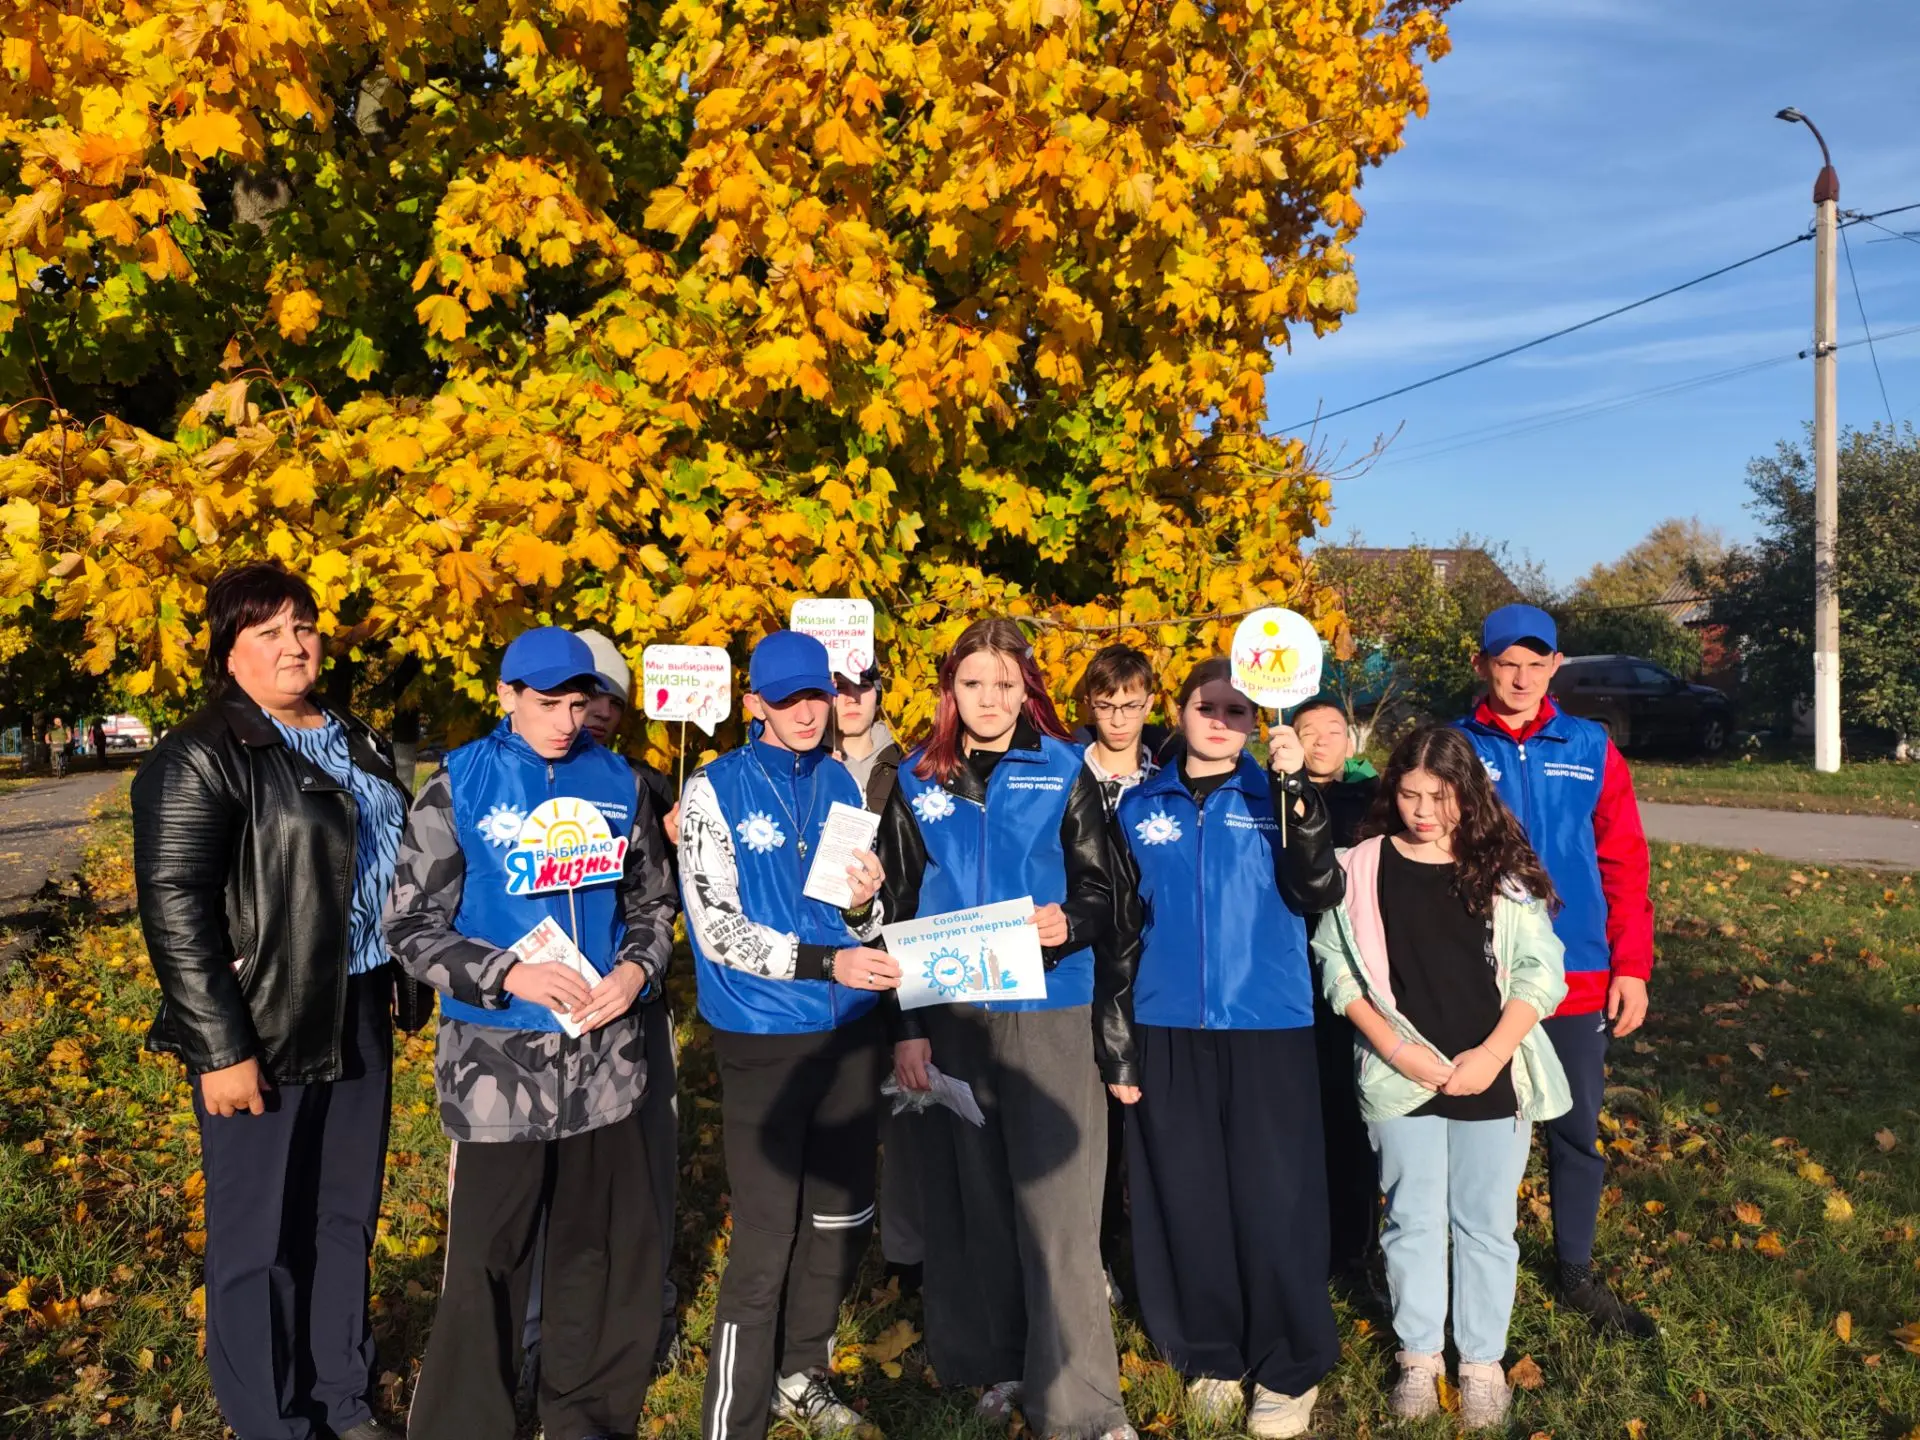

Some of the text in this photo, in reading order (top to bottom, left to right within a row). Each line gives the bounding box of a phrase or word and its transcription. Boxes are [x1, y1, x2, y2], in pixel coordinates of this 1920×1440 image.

[796, 615, 836, 625] Жизни
[848, 615, 869, 625] ДА!
[645, 660, 725, 673] Мы выбираем
[645, 673, 701, 687] ЖИЗНЬ
[536, 841, 613, 861] ВЫБИРАЮ
[506, 850, 537, 893] Я
[933, 910, 984, 926] Сообщи,
[897, 916, 1027, 946] где торгуют смертью!
